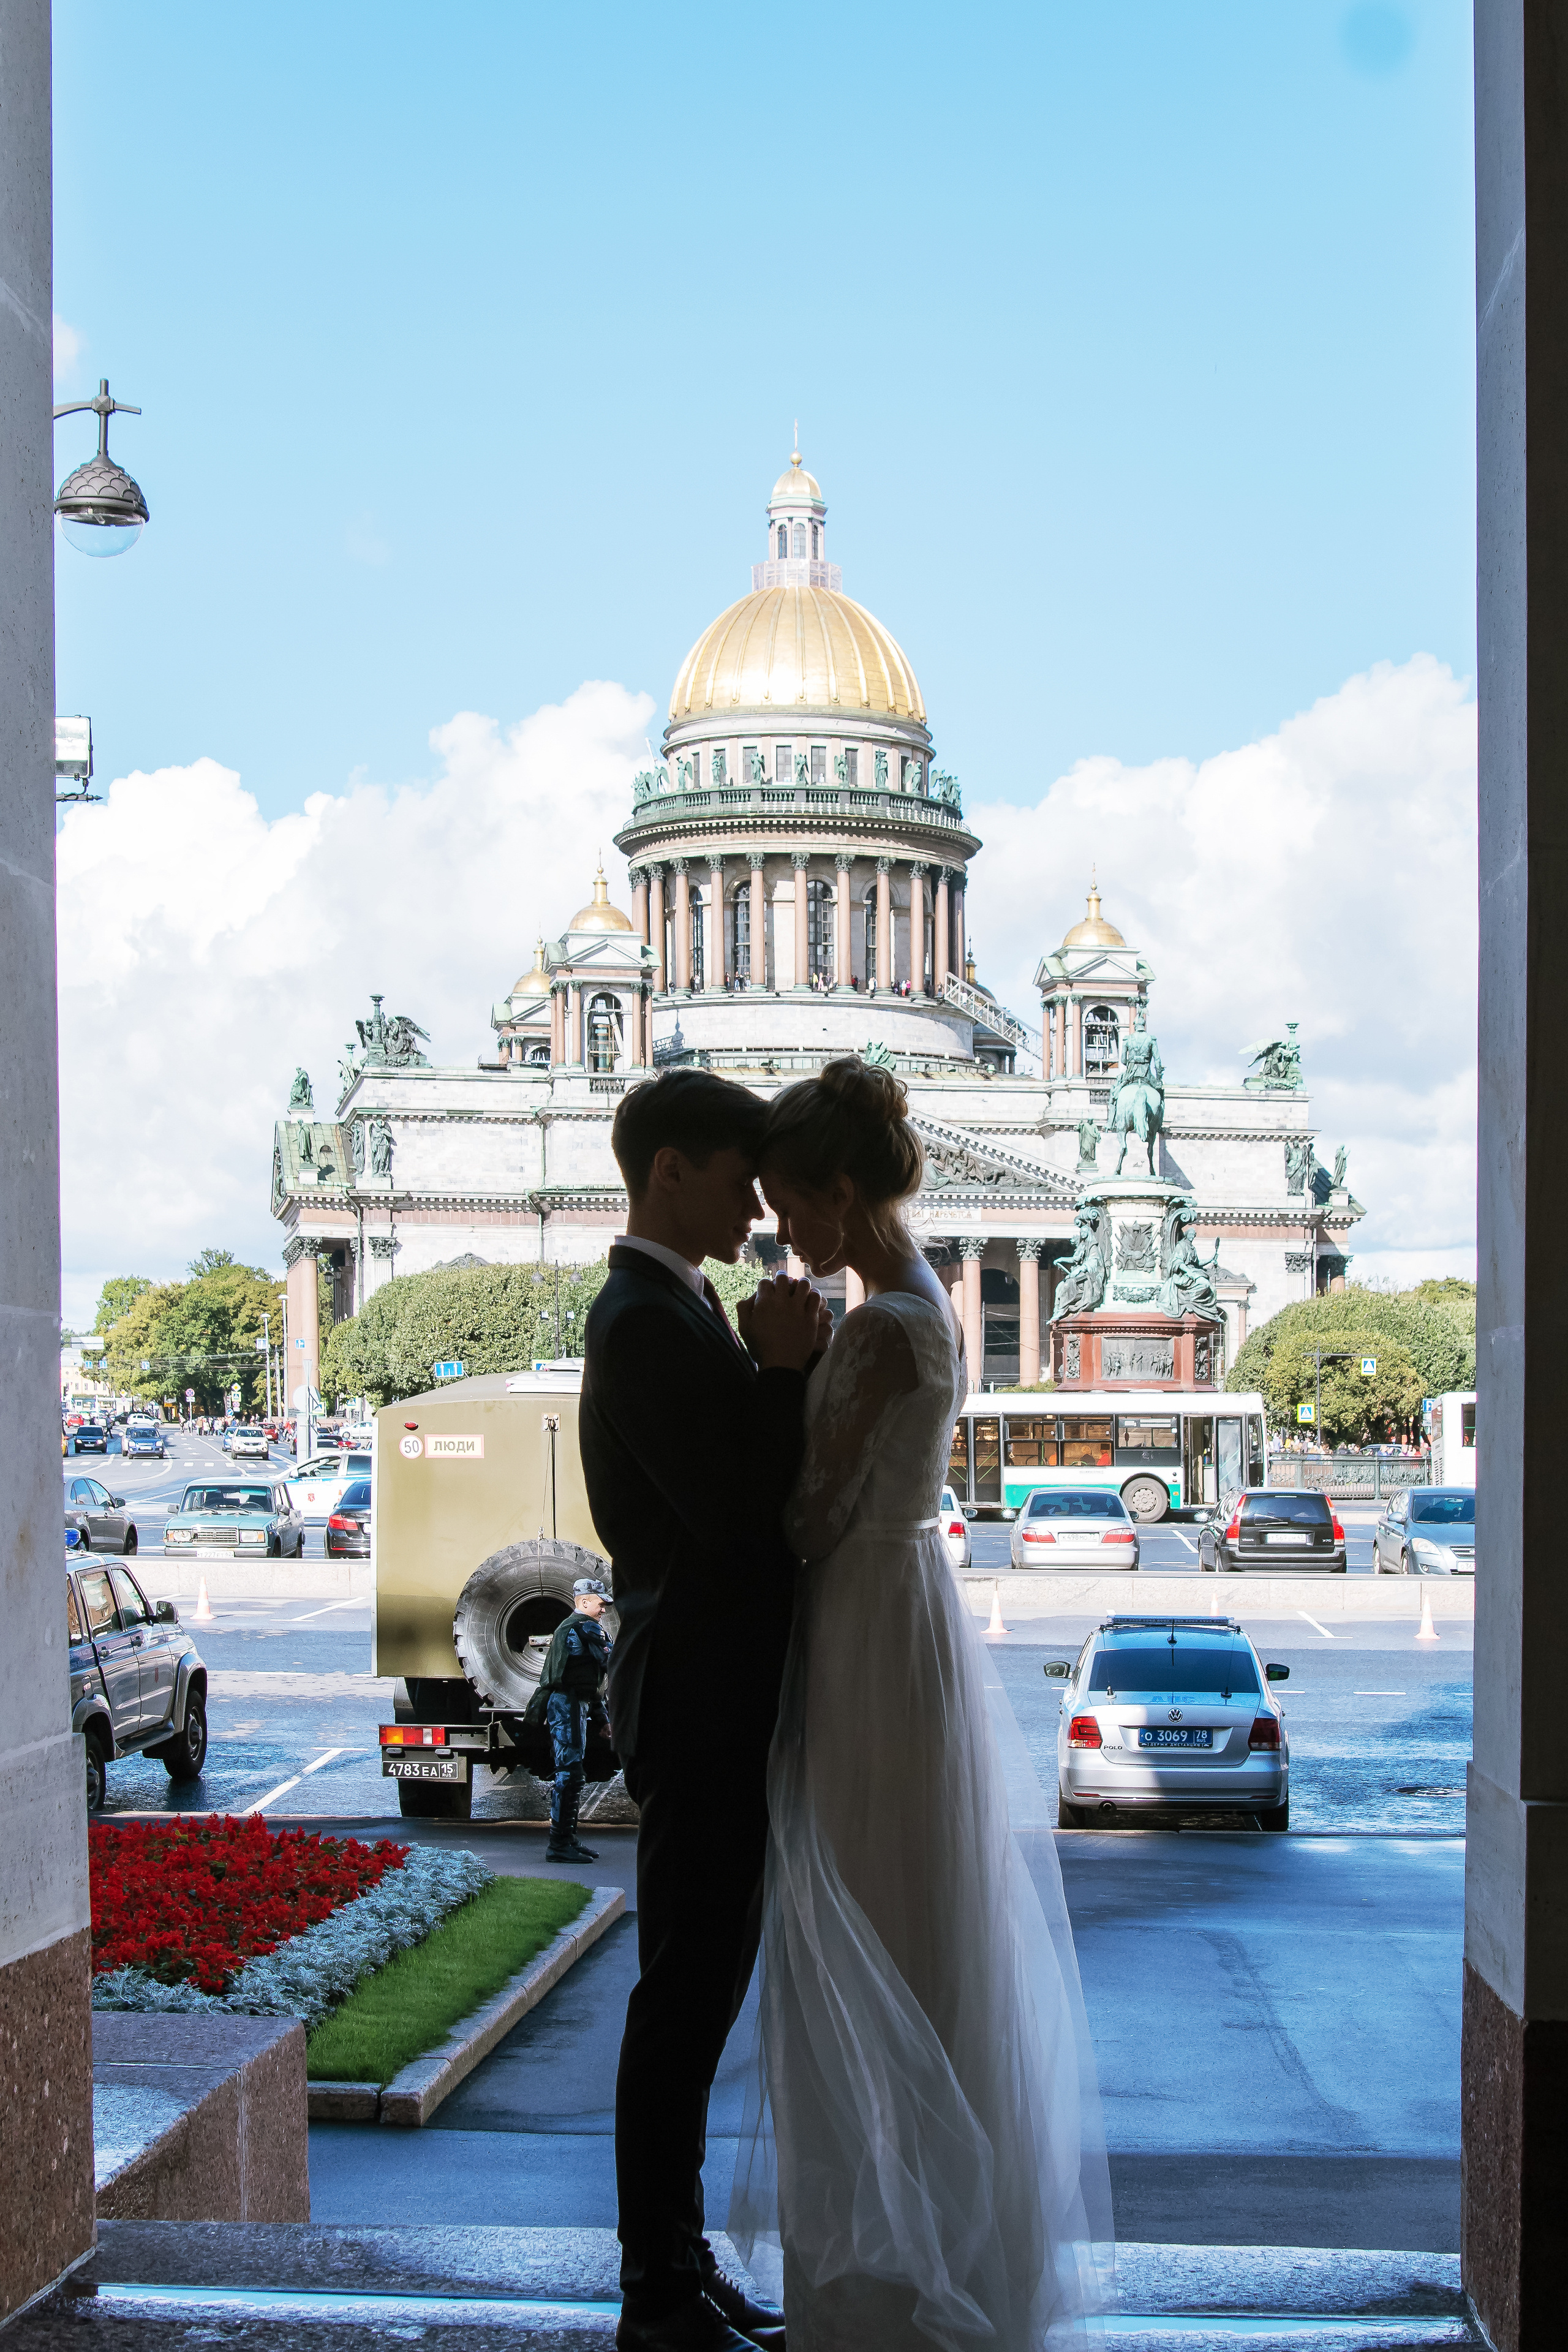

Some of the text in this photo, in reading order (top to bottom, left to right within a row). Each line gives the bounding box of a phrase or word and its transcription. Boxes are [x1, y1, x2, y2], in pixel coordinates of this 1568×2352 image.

[404, 1440, 420, 1453] 50
[434, 1441, 475, 1453] ЛЮДИ
[1196, 1730, 1207, 1739] 78
[441, 1763, 453, 1773] 15
